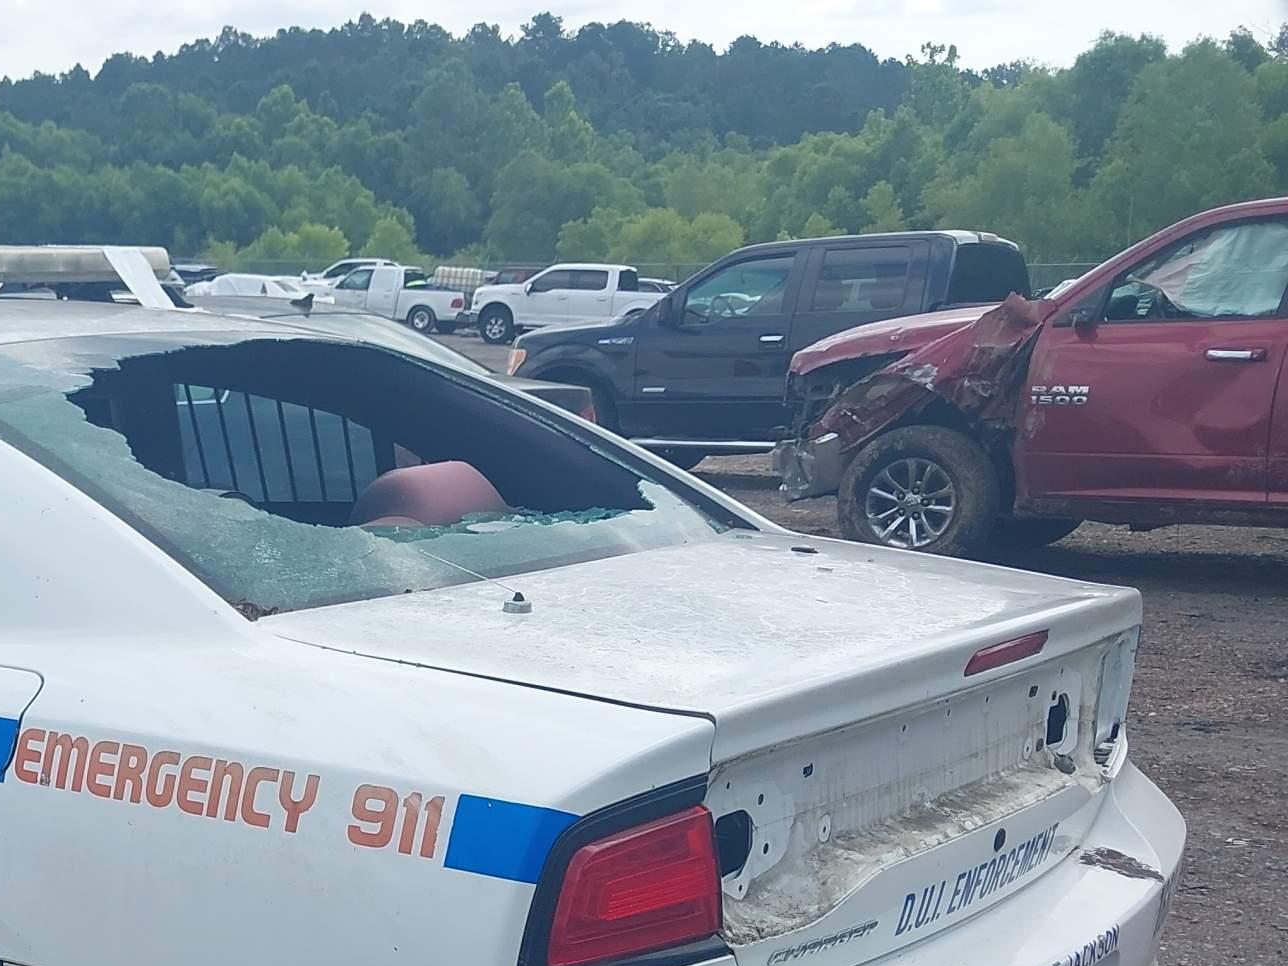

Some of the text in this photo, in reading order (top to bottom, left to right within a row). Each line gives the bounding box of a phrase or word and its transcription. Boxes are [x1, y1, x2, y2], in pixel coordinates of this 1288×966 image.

[1031, 385, 1089, 395] RAM
[1031, 396, 1087, 406] 1500
[15, 728, 446, 860] EMERGENCY 911
[894, 880, 946, 937] D.U.I.
[947, 823, 1060, 915] ENFORCEMENT
